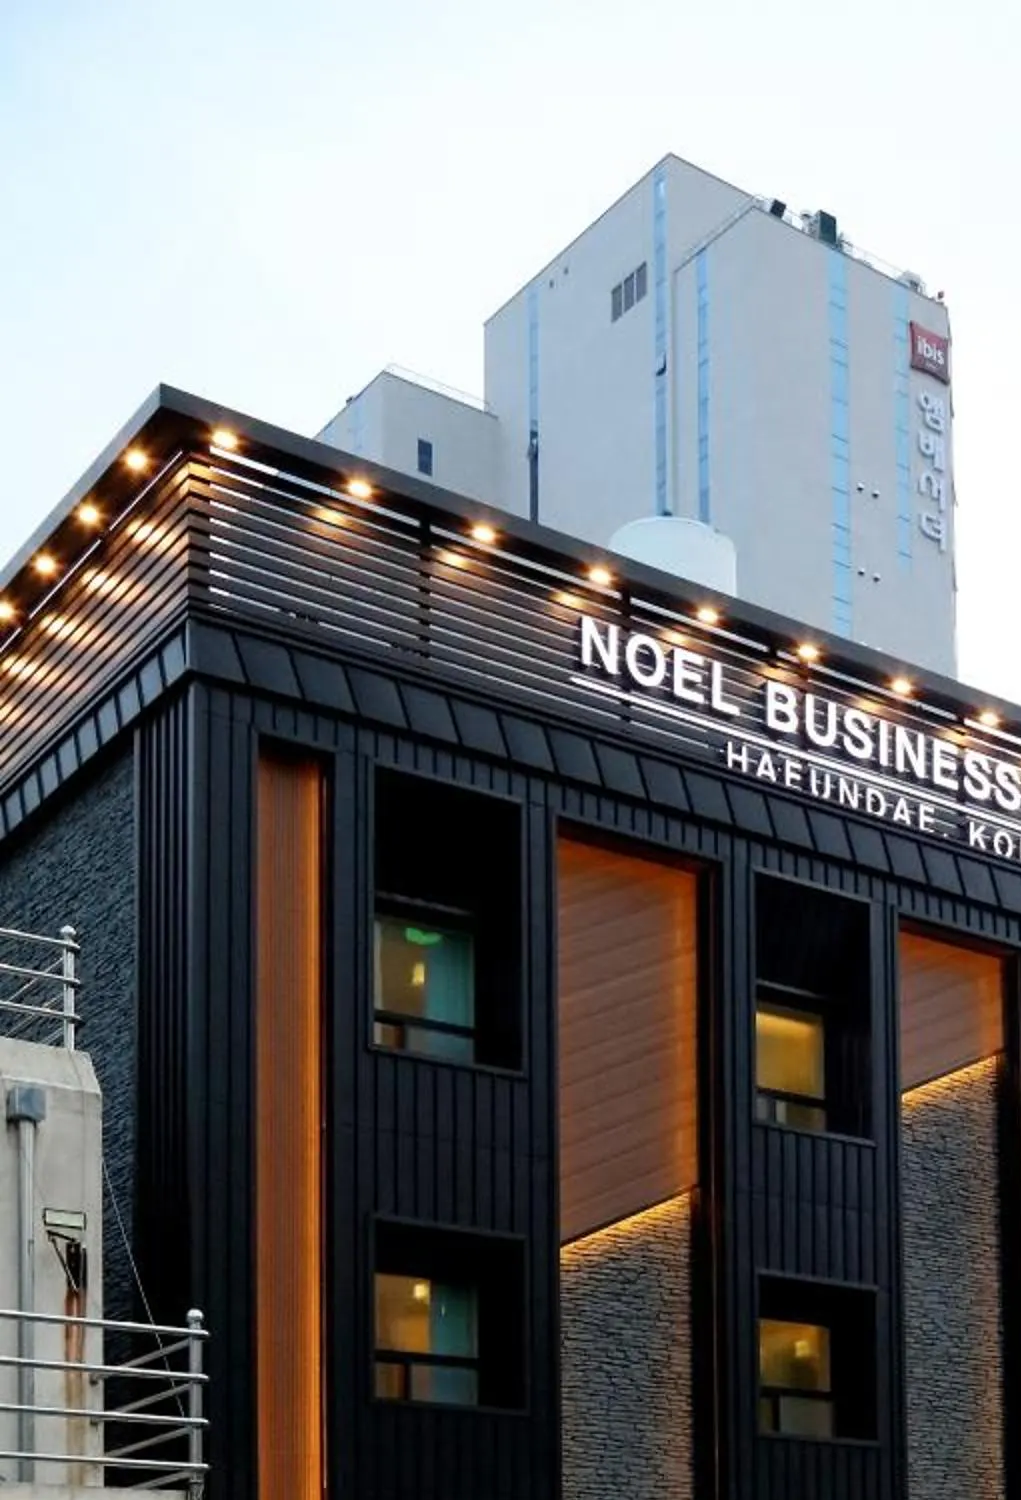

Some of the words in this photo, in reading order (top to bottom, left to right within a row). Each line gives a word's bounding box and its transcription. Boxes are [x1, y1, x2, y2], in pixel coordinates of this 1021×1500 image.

[916, 335, 945, 365] ibis
[580, 615, 742, 717] NOEL
[765, 680, 1021, 812] BUSINESS
